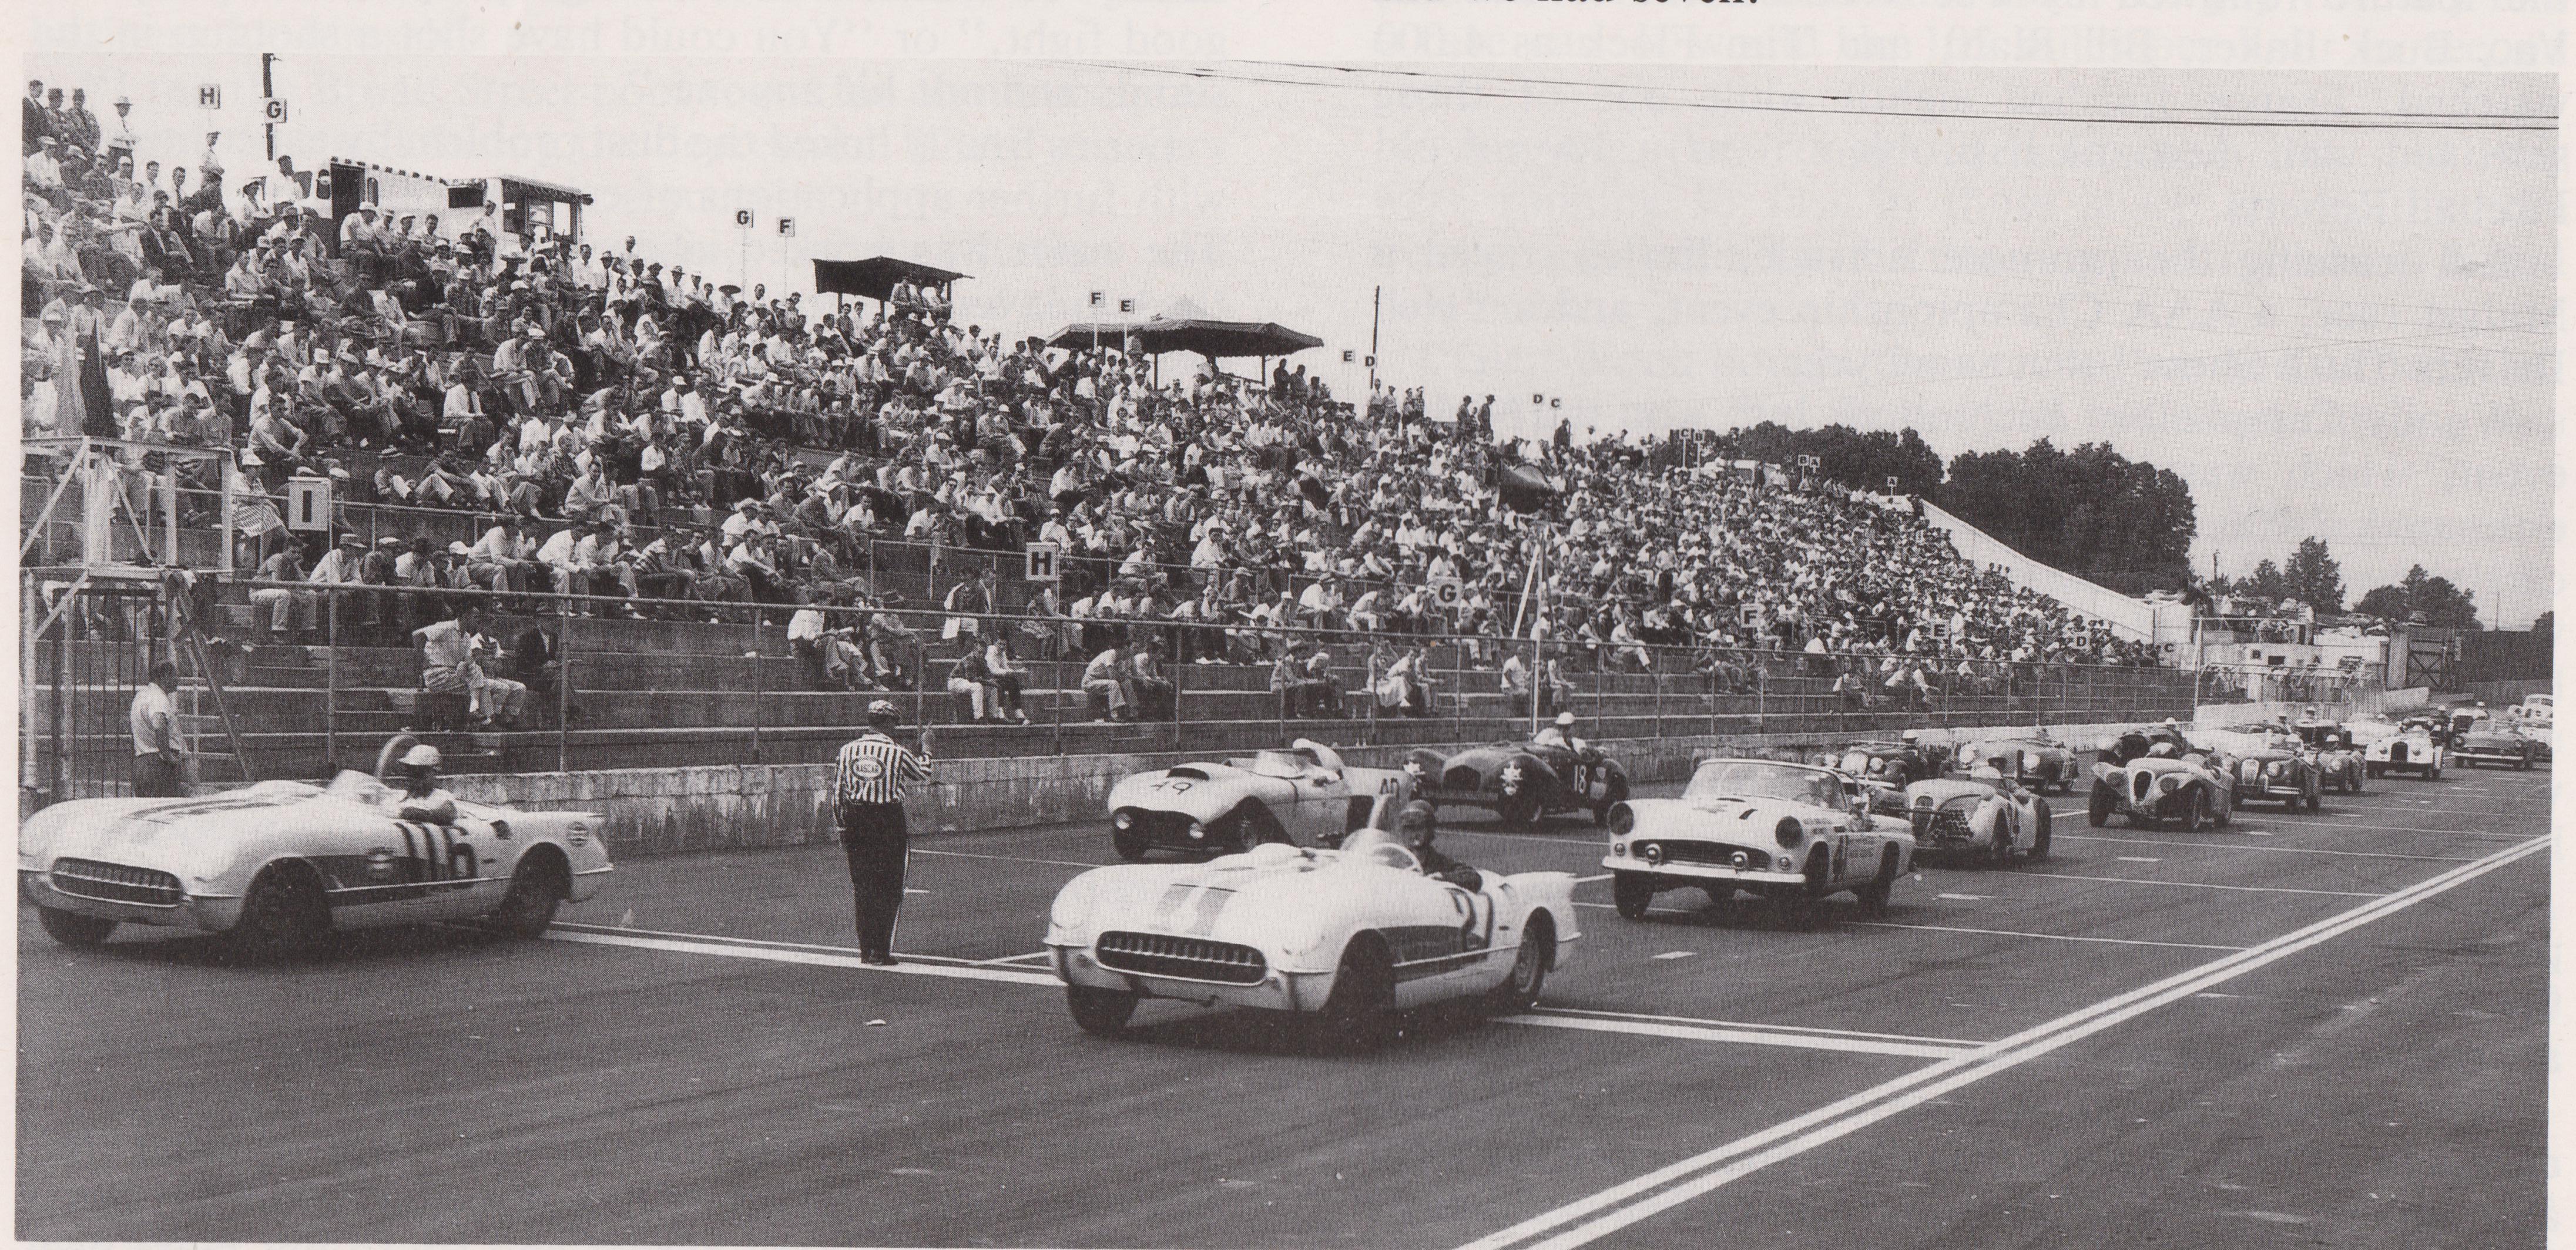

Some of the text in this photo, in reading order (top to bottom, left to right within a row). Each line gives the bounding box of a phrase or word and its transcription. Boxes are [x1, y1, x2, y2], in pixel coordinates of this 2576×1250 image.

[200, 88, 214, 105] H
[266, 101, 281, 119] G
[737, 210, 749, 224] G
[780, 219, 791, 233] F
[1091, 292, 1101, 304] F
[1121, 300, 1131, 312] E
[1343, 350, 1353, 361] E
[1365, 356, 1375, 367] D
[1533, 394, 1542, 404] D
[1551, 399, 1560, 408] C
[1031, 551, 1051, 576] H
[1439, 584, 1457, 603] G
[1744, 610, 1757, 624] F
[1934, 624, 1946, 637] E
[2077, 636, 2087, 647] D
[2164, 643, 2174, 652] C
[1574, 764, 1587, 794] 18
[393, 822, 477, 890] 116
